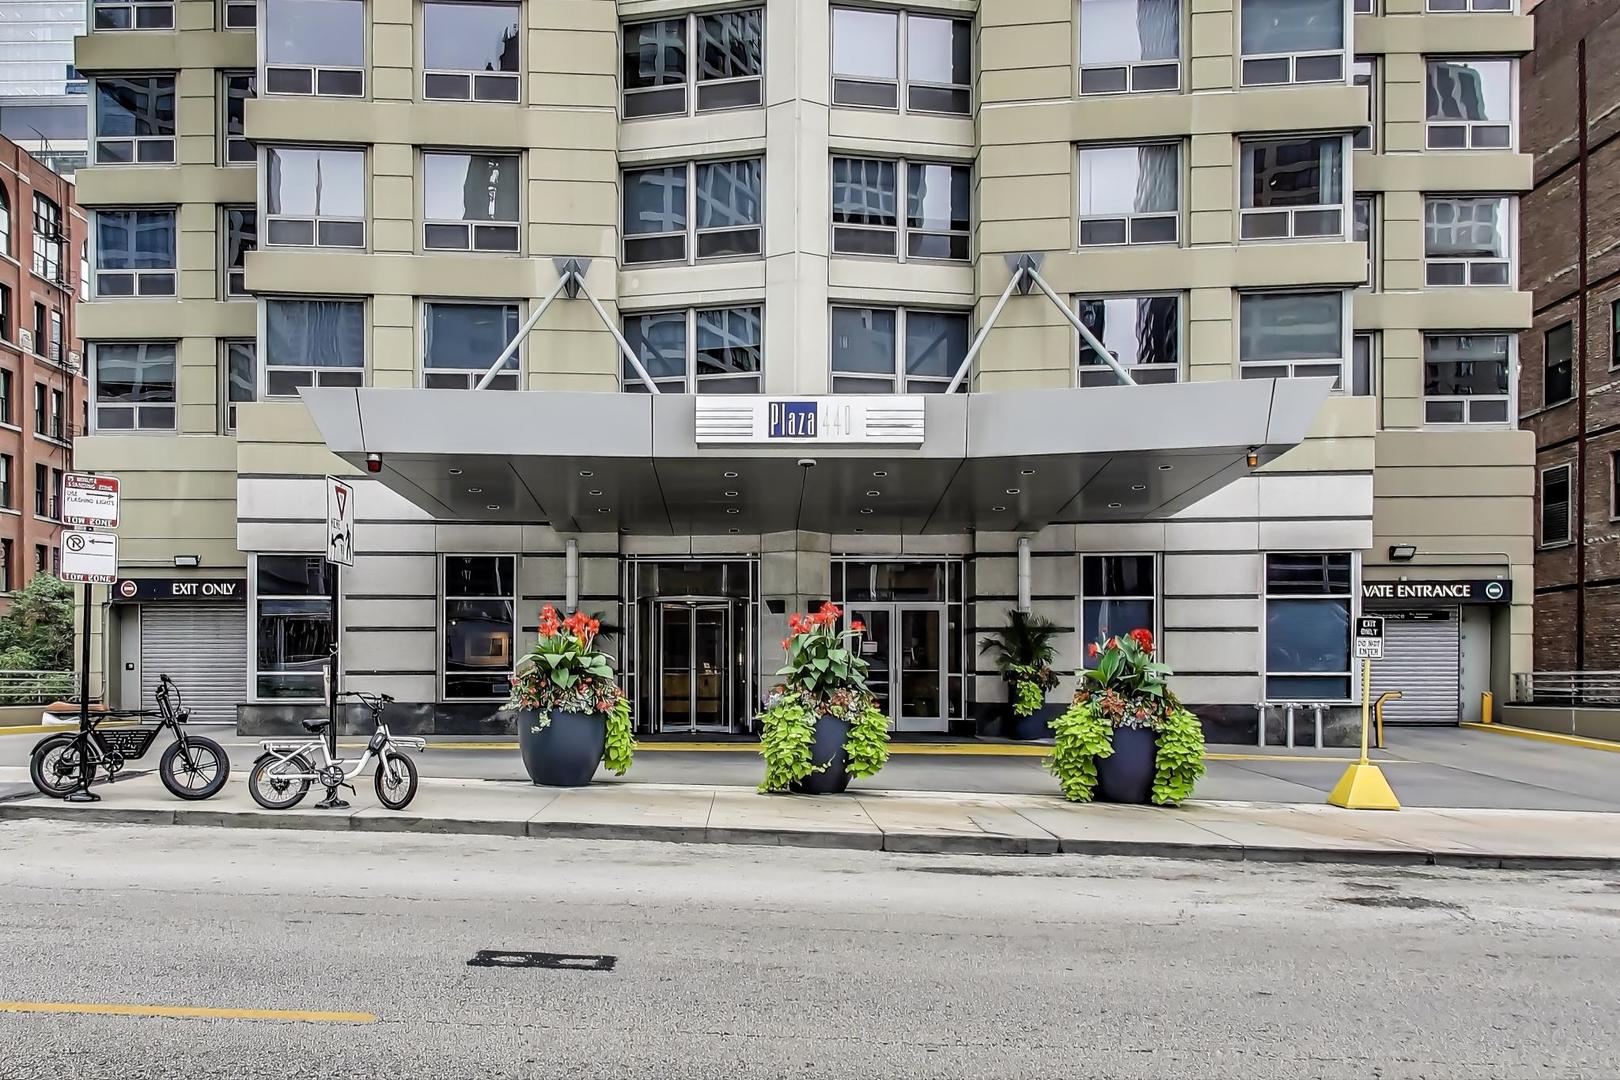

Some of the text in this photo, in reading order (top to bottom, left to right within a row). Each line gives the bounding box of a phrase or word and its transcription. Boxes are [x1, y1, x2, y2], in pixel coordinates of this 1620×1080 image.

[770, 402, 851, 436] Plaza 440
[172, 583, 236, 595] EXIT ONLY
[1362, 584, 1471, 598] VATE ENTRANCE
